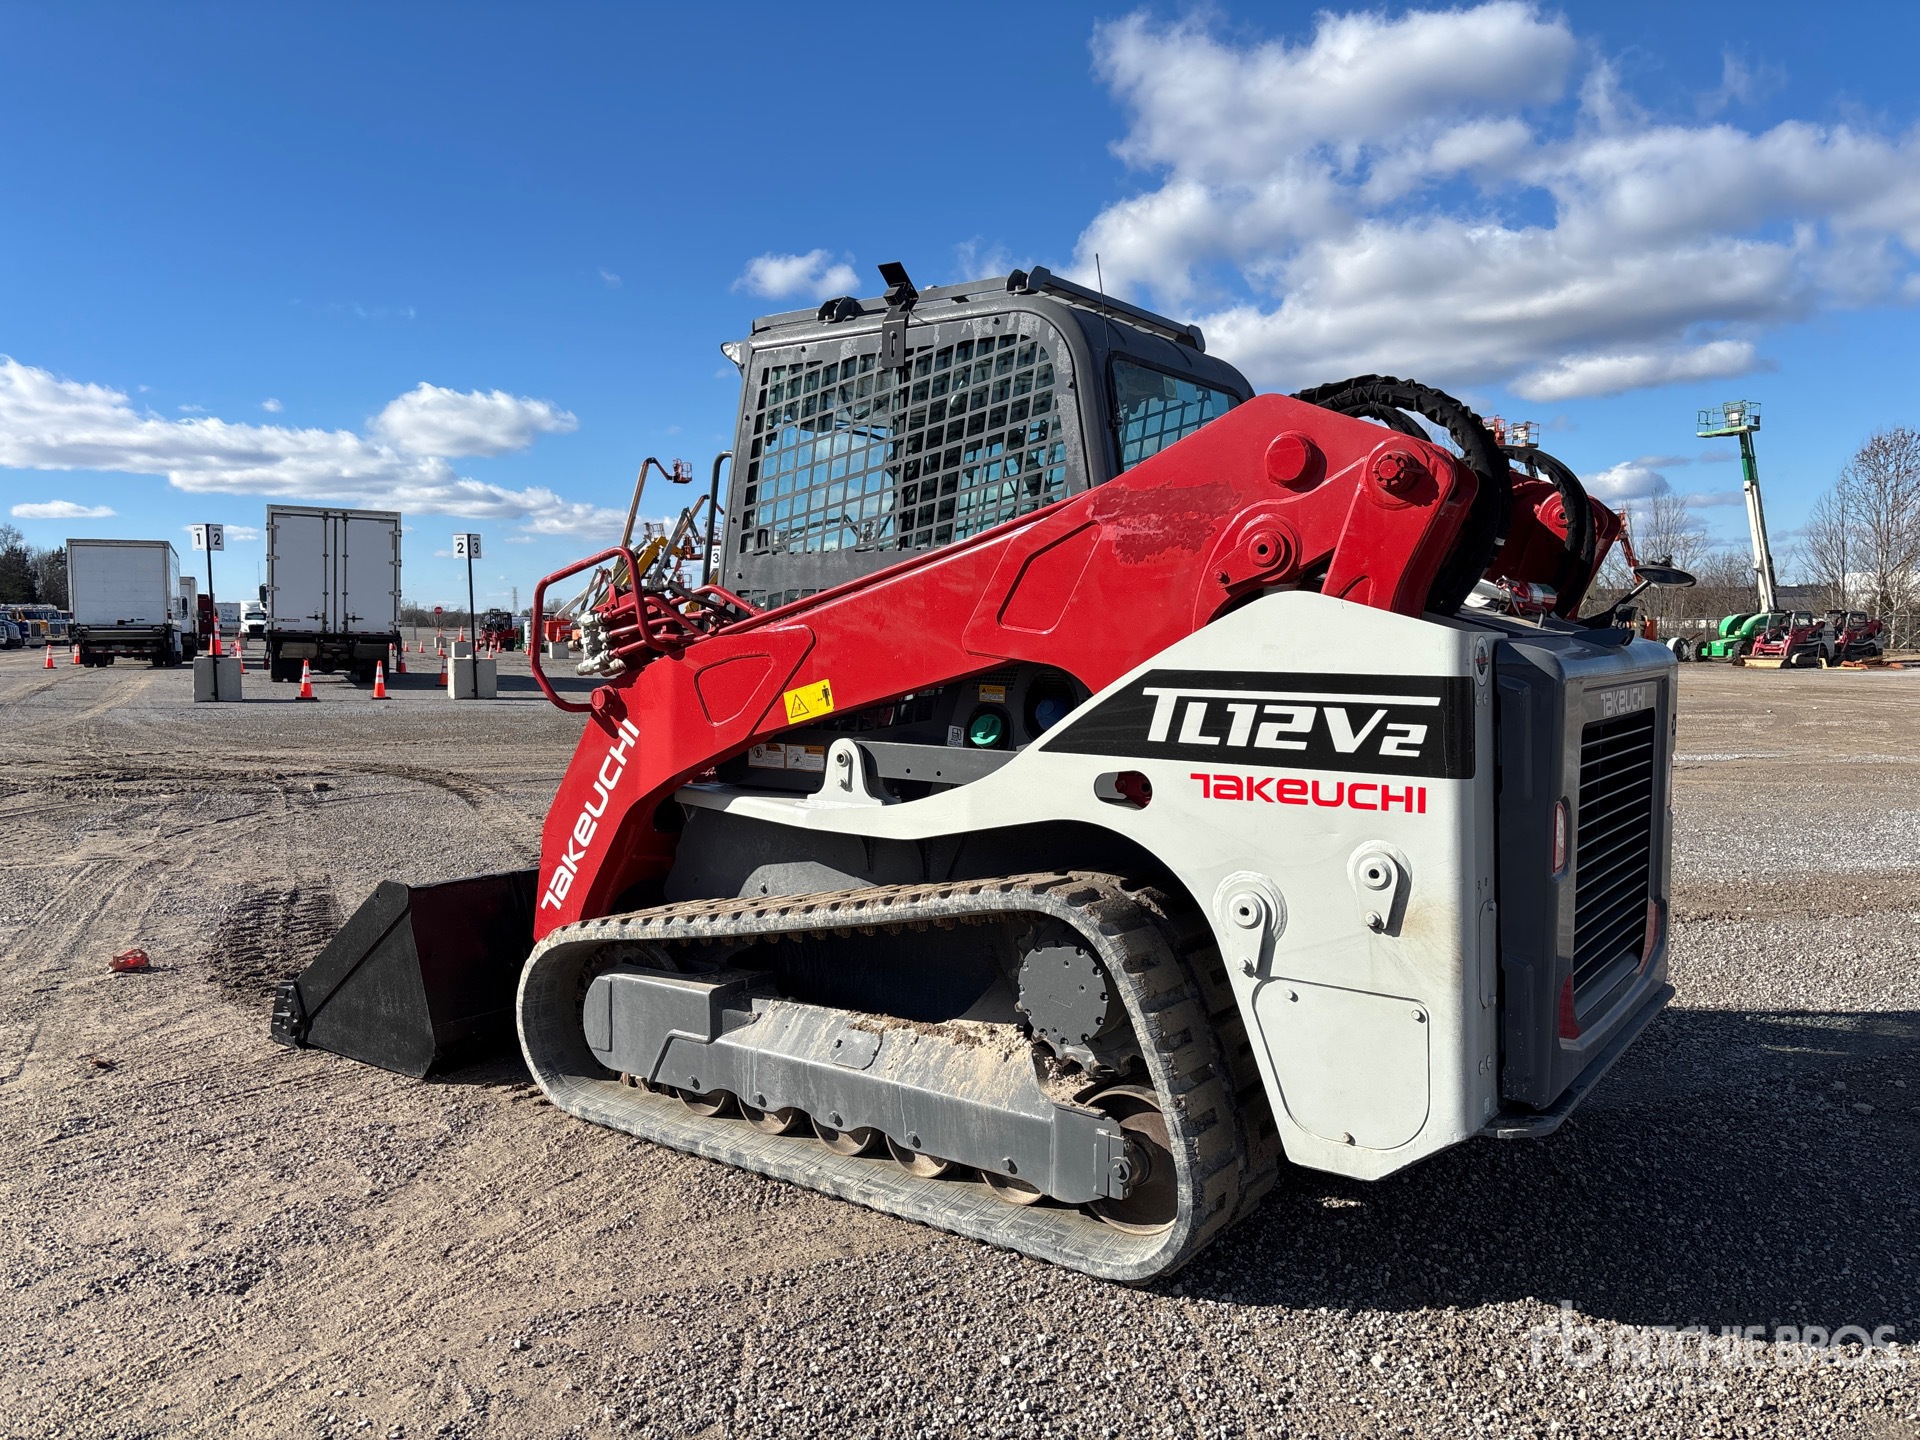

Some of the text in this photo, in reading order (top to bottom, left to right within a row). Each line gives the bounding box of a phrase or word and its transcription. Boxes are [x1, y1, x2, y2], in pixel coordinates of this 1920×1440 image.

[196, 533, 201, 545] 1
[213, 533, 221, 545] 2
[457, 542, 464, 554] 2
[473, 542, 479, 554] 3
[712, 552, 720, 564] 3
